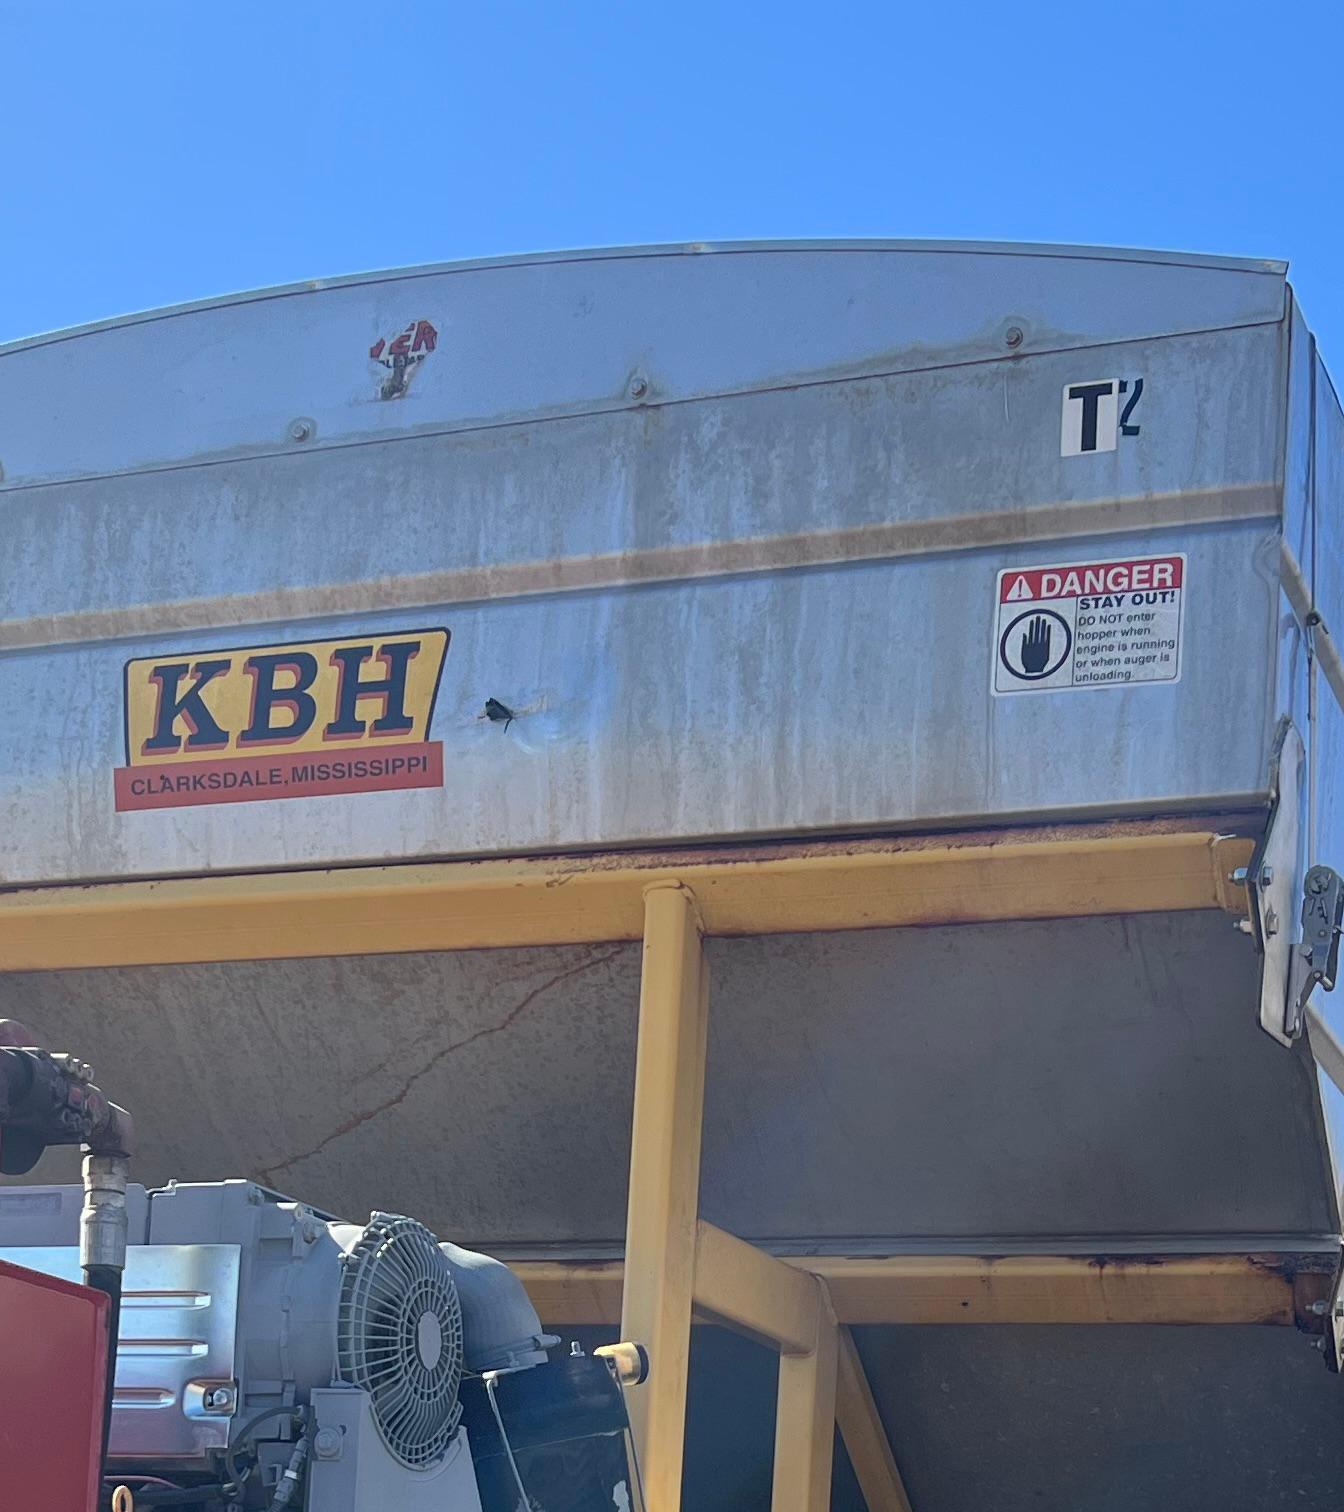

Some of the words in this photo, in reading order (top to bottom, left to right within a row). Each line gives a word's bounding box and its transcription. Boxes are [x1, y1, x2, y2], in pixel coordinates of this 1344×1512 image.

[1068, 378, 1144, 452] T2
[1040, 562, 1174, 598] DANGER
[1079, 594, 1126, 611] STAY
[1131, 590, 1175, 606] OUT!
[1078, 615, 1096, 627] DO
[1099, 614, 1123, 624] NOT
[1126, 612, 1156, 623] enter
[1077, 629, 1118, 643] hopper
[1120, 626, 1151, 638] when
[1076, 642, 1115, 656] engine
[1117, 641, 1128, 652] is
[1130, 638, 1175, 650] running
[1075, 659, 1087, 669] or
[1090, 655, 1121, 667] when
[1123, 654, 1157, 666] auger
[1159, 652, 1170, 662] is
[141, 640, 422, 757] KBH
[291, 755, 428, 784] MISSISSIPPI
